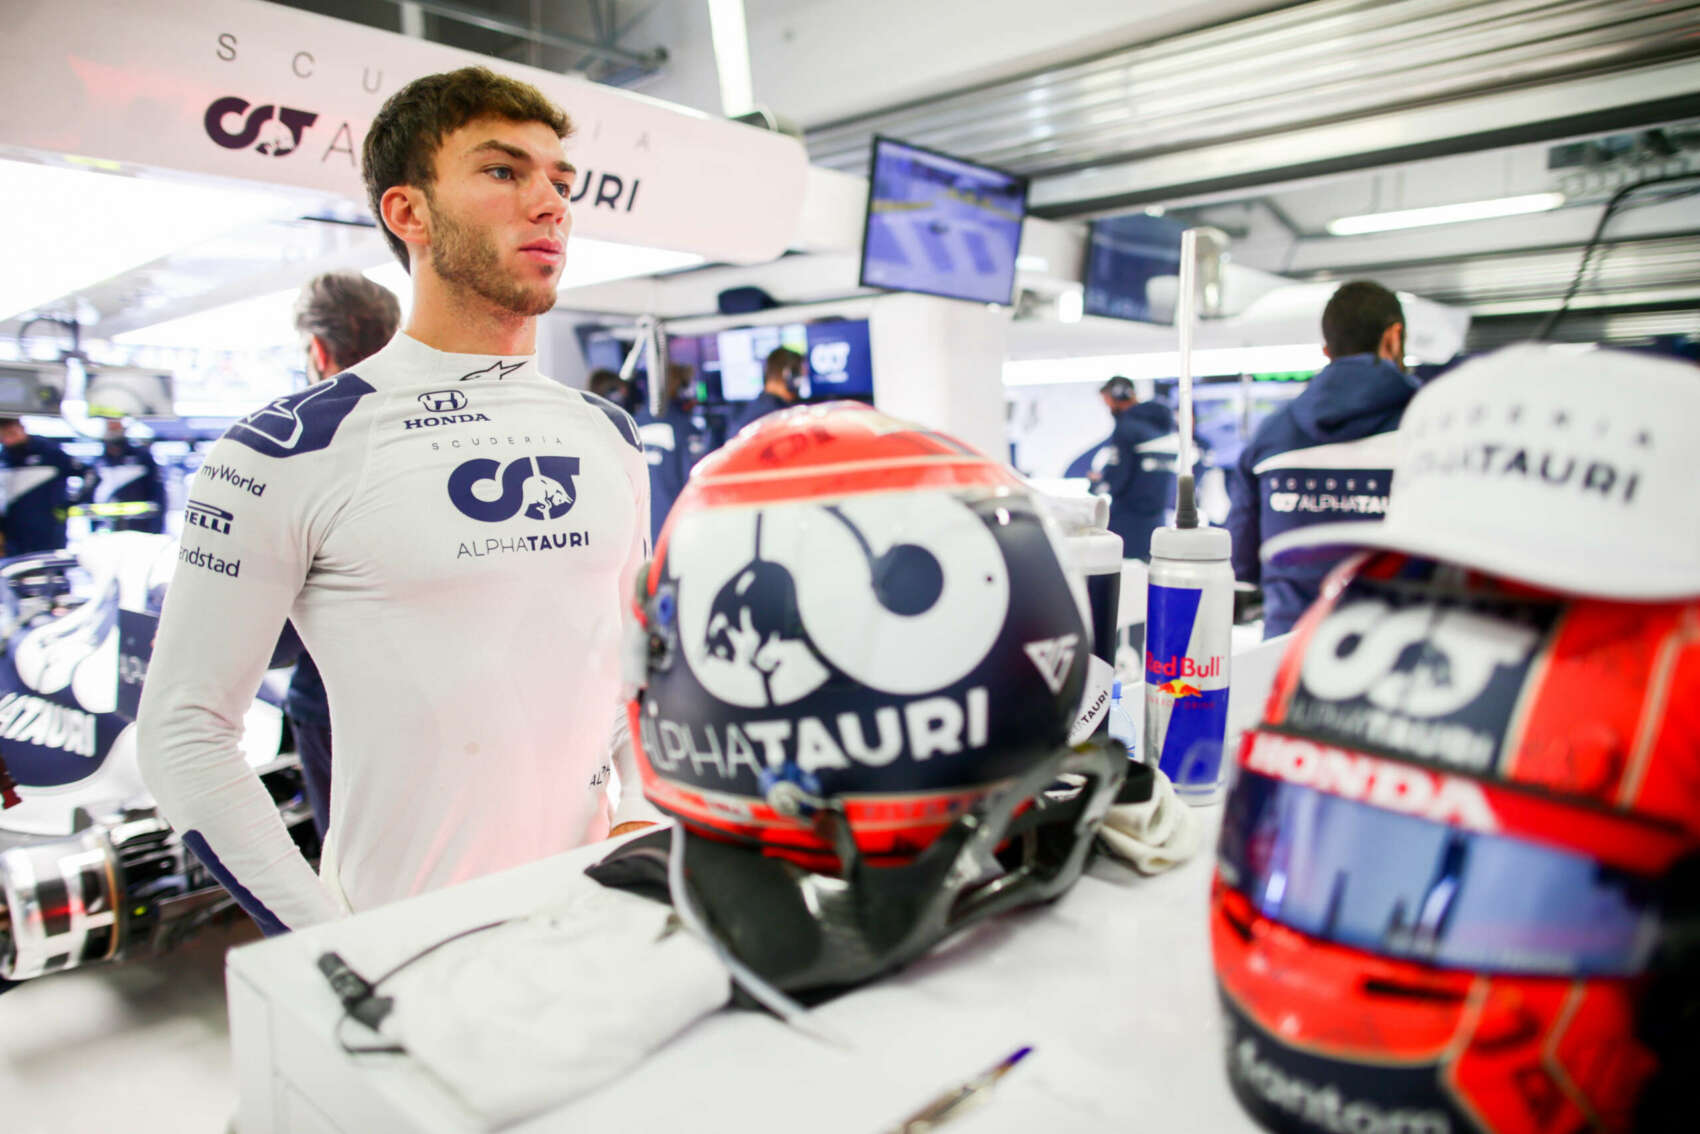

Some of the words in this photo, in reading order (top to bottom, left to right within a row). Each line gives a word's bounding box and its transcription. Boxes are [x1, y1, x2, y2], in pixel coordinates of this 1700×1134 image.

[404, 413, 491, 429] HONDA
[431, 435, 563, 451] SCUDERIA
[202, 464, 266, 497] myWorld
[457, 531, 589, 559] ALPHATAURI
[1146, 650, 1176, 676] Red
[1181, 656, 1220, 678] Bull
[641, 688, 988, 778] ALPHATAURI
[1249, 732, 1499, 831] HONDA
